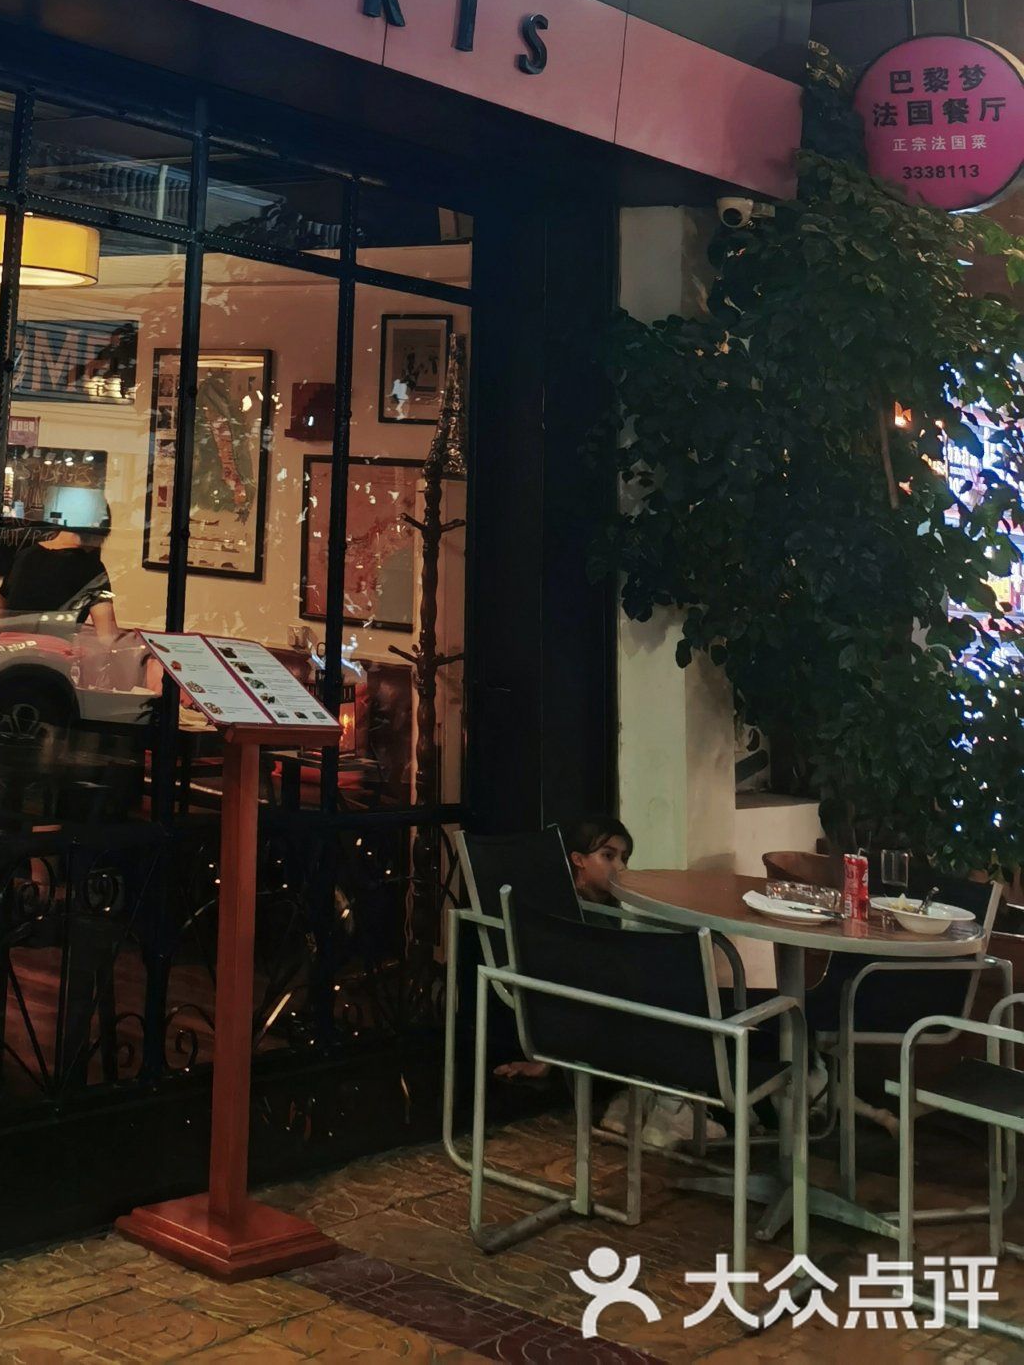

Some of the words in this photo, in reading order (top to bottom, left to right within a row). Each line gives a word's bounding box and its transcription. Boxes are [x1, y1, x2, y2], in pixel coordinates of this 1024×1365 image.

[889, 64, 987, 94] 巴黎梦
[872, 97, 1006, 127] 法国餐厅
[892, 134, 987, 152] 正宗法国菜
[902, 164, 981, 180] 3338113
